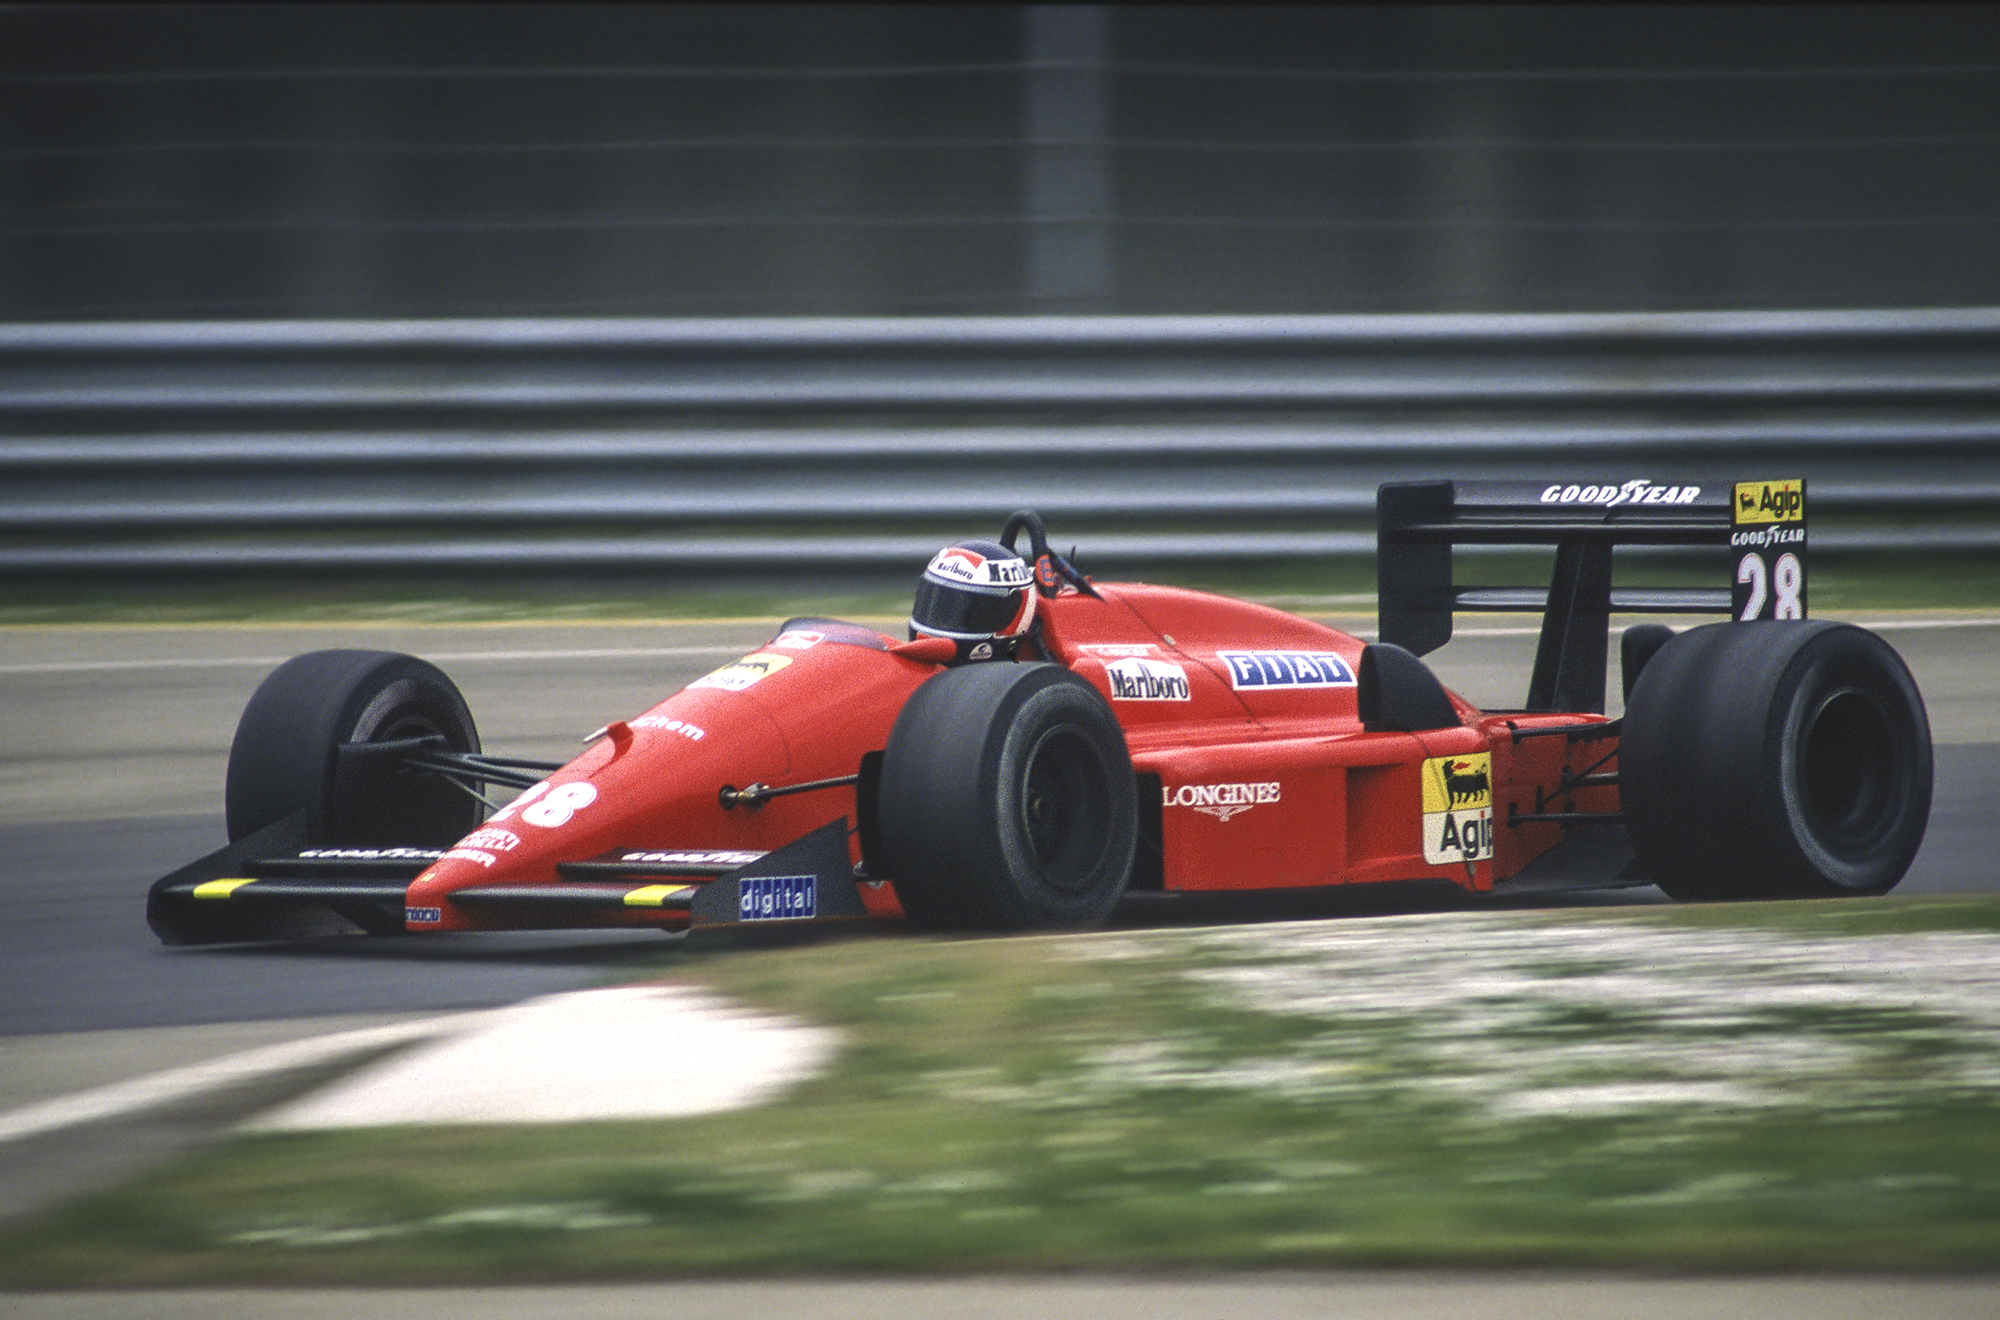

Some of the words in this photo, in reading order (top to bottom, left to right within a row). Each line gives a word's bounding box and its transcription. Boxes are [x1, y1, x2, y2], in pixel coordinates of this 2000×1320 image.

[1541, 480, 1701, 507] GOODYEAR
[1760, 484, 1802, 519] Agip
[1731, 525, 1806, 549] GOODYEAR
[937, 561, 974, 580] Marlboro
[1737, 552, 1802, 621] 28
[1109, 662, 1189, 699] Marlboro
[1233, 654, 1347, 682] FIAT
[1162, 781, 1281, 806] LONGINES
[741, 886, 812, 915] digital
